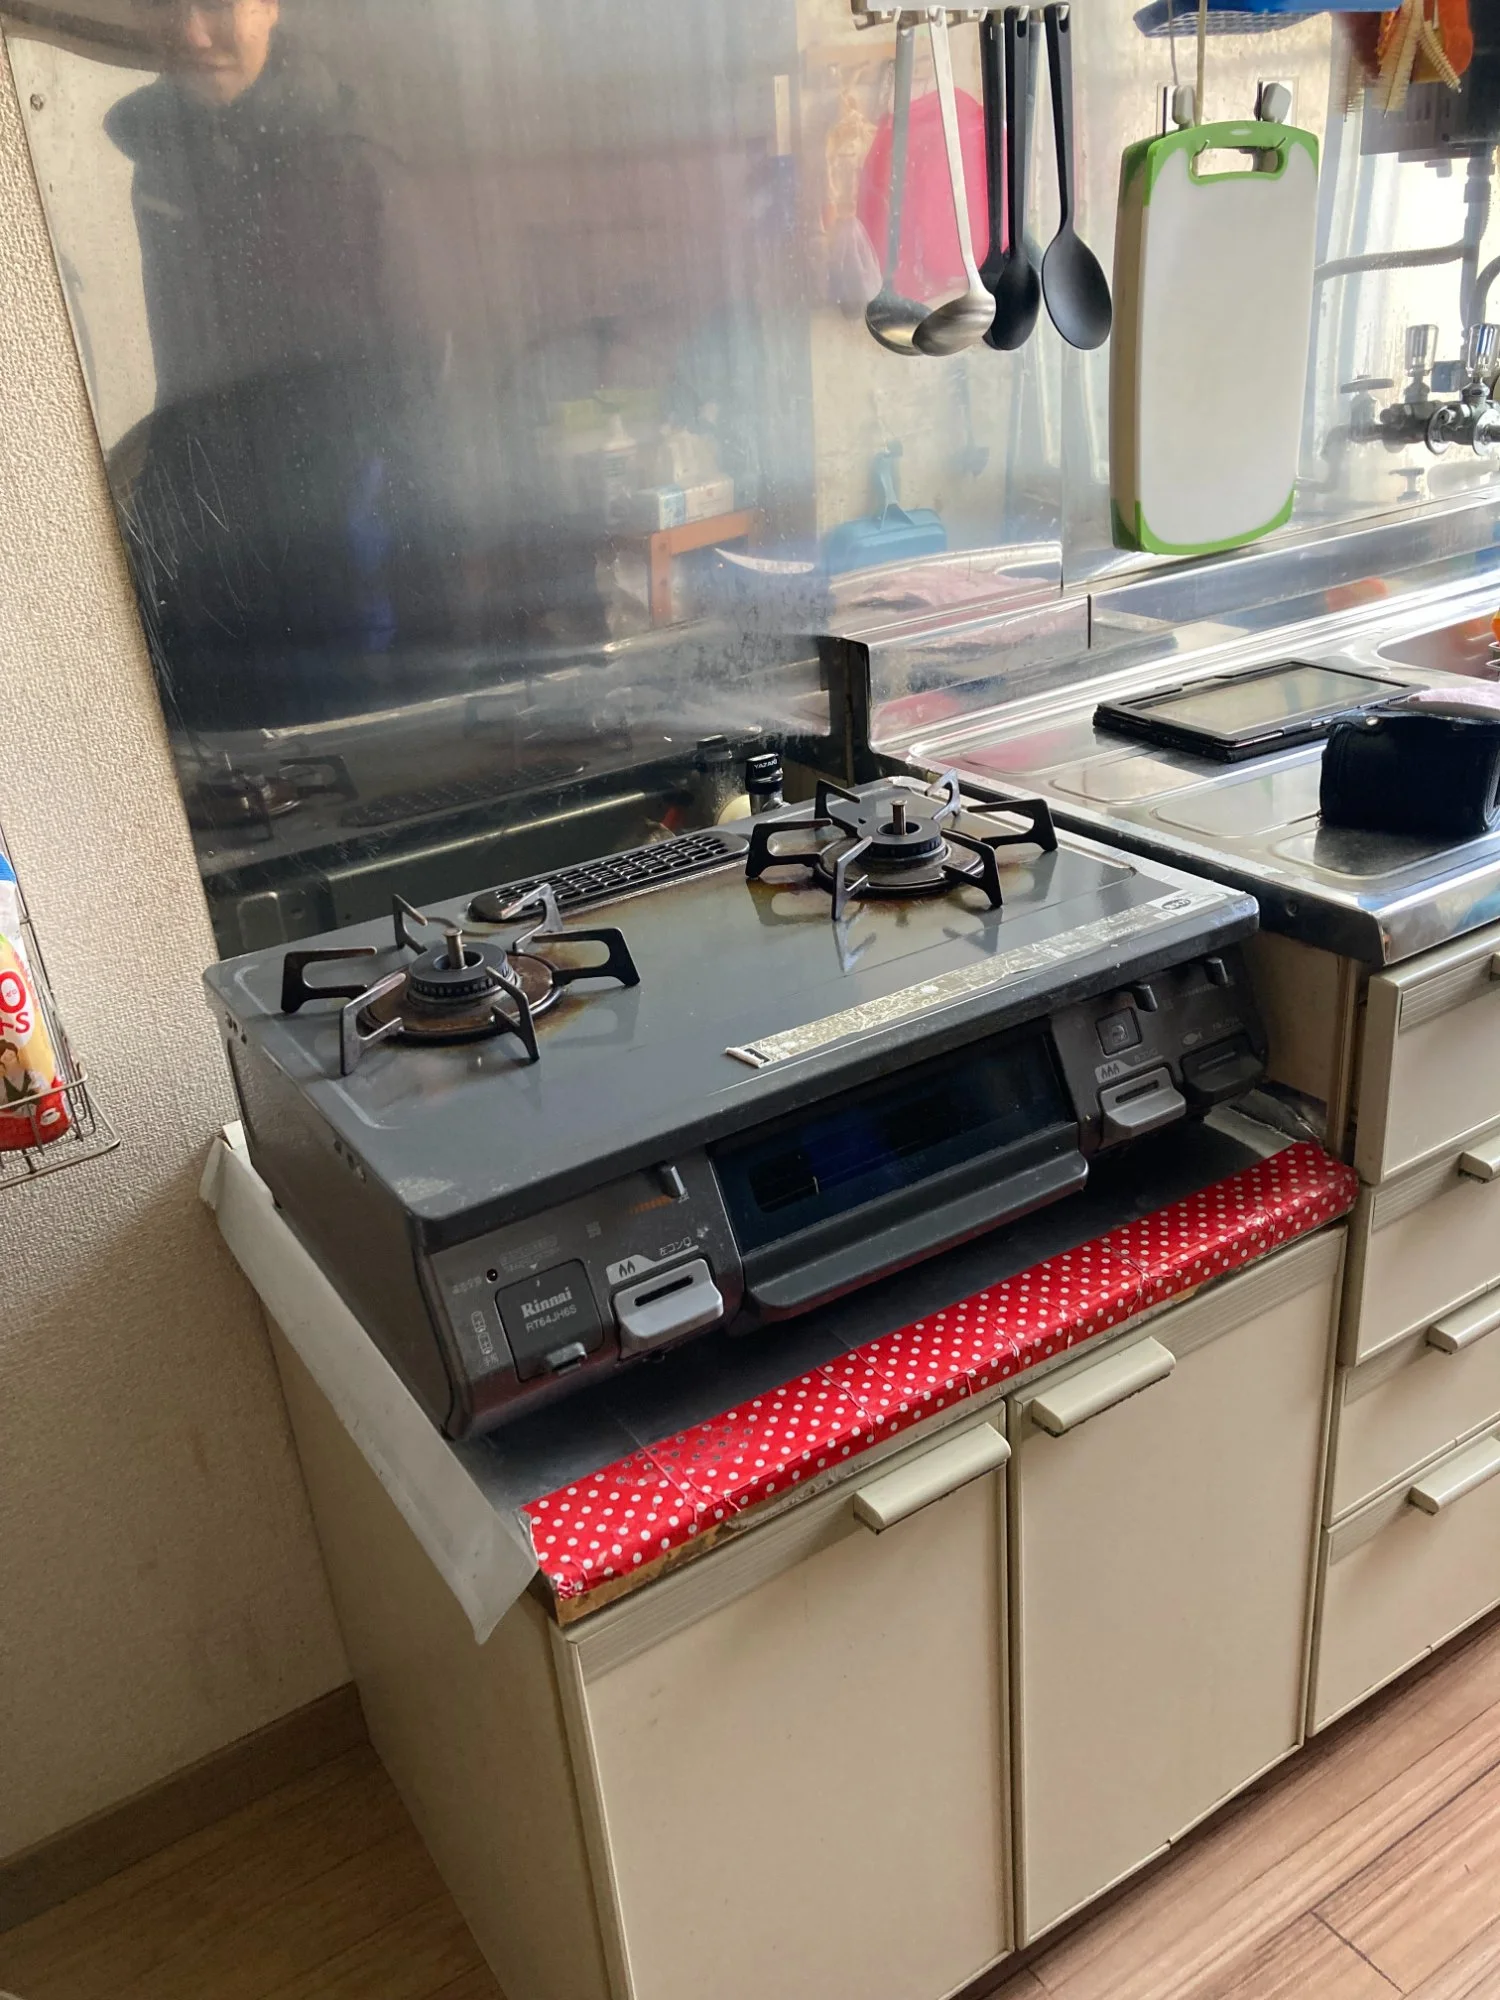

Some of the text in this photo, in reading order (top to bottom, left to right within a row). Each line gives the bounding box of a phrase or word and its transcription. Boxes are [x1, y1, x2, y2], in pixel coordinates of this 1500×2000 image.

[754, 758, 777, 769] YAZAKI
[659, 1236, 691, 1256] 左コンロ
[520, 1286, 573, 1318] Rinnai
[525, 1304, 577, 1332] RT64JH6S
